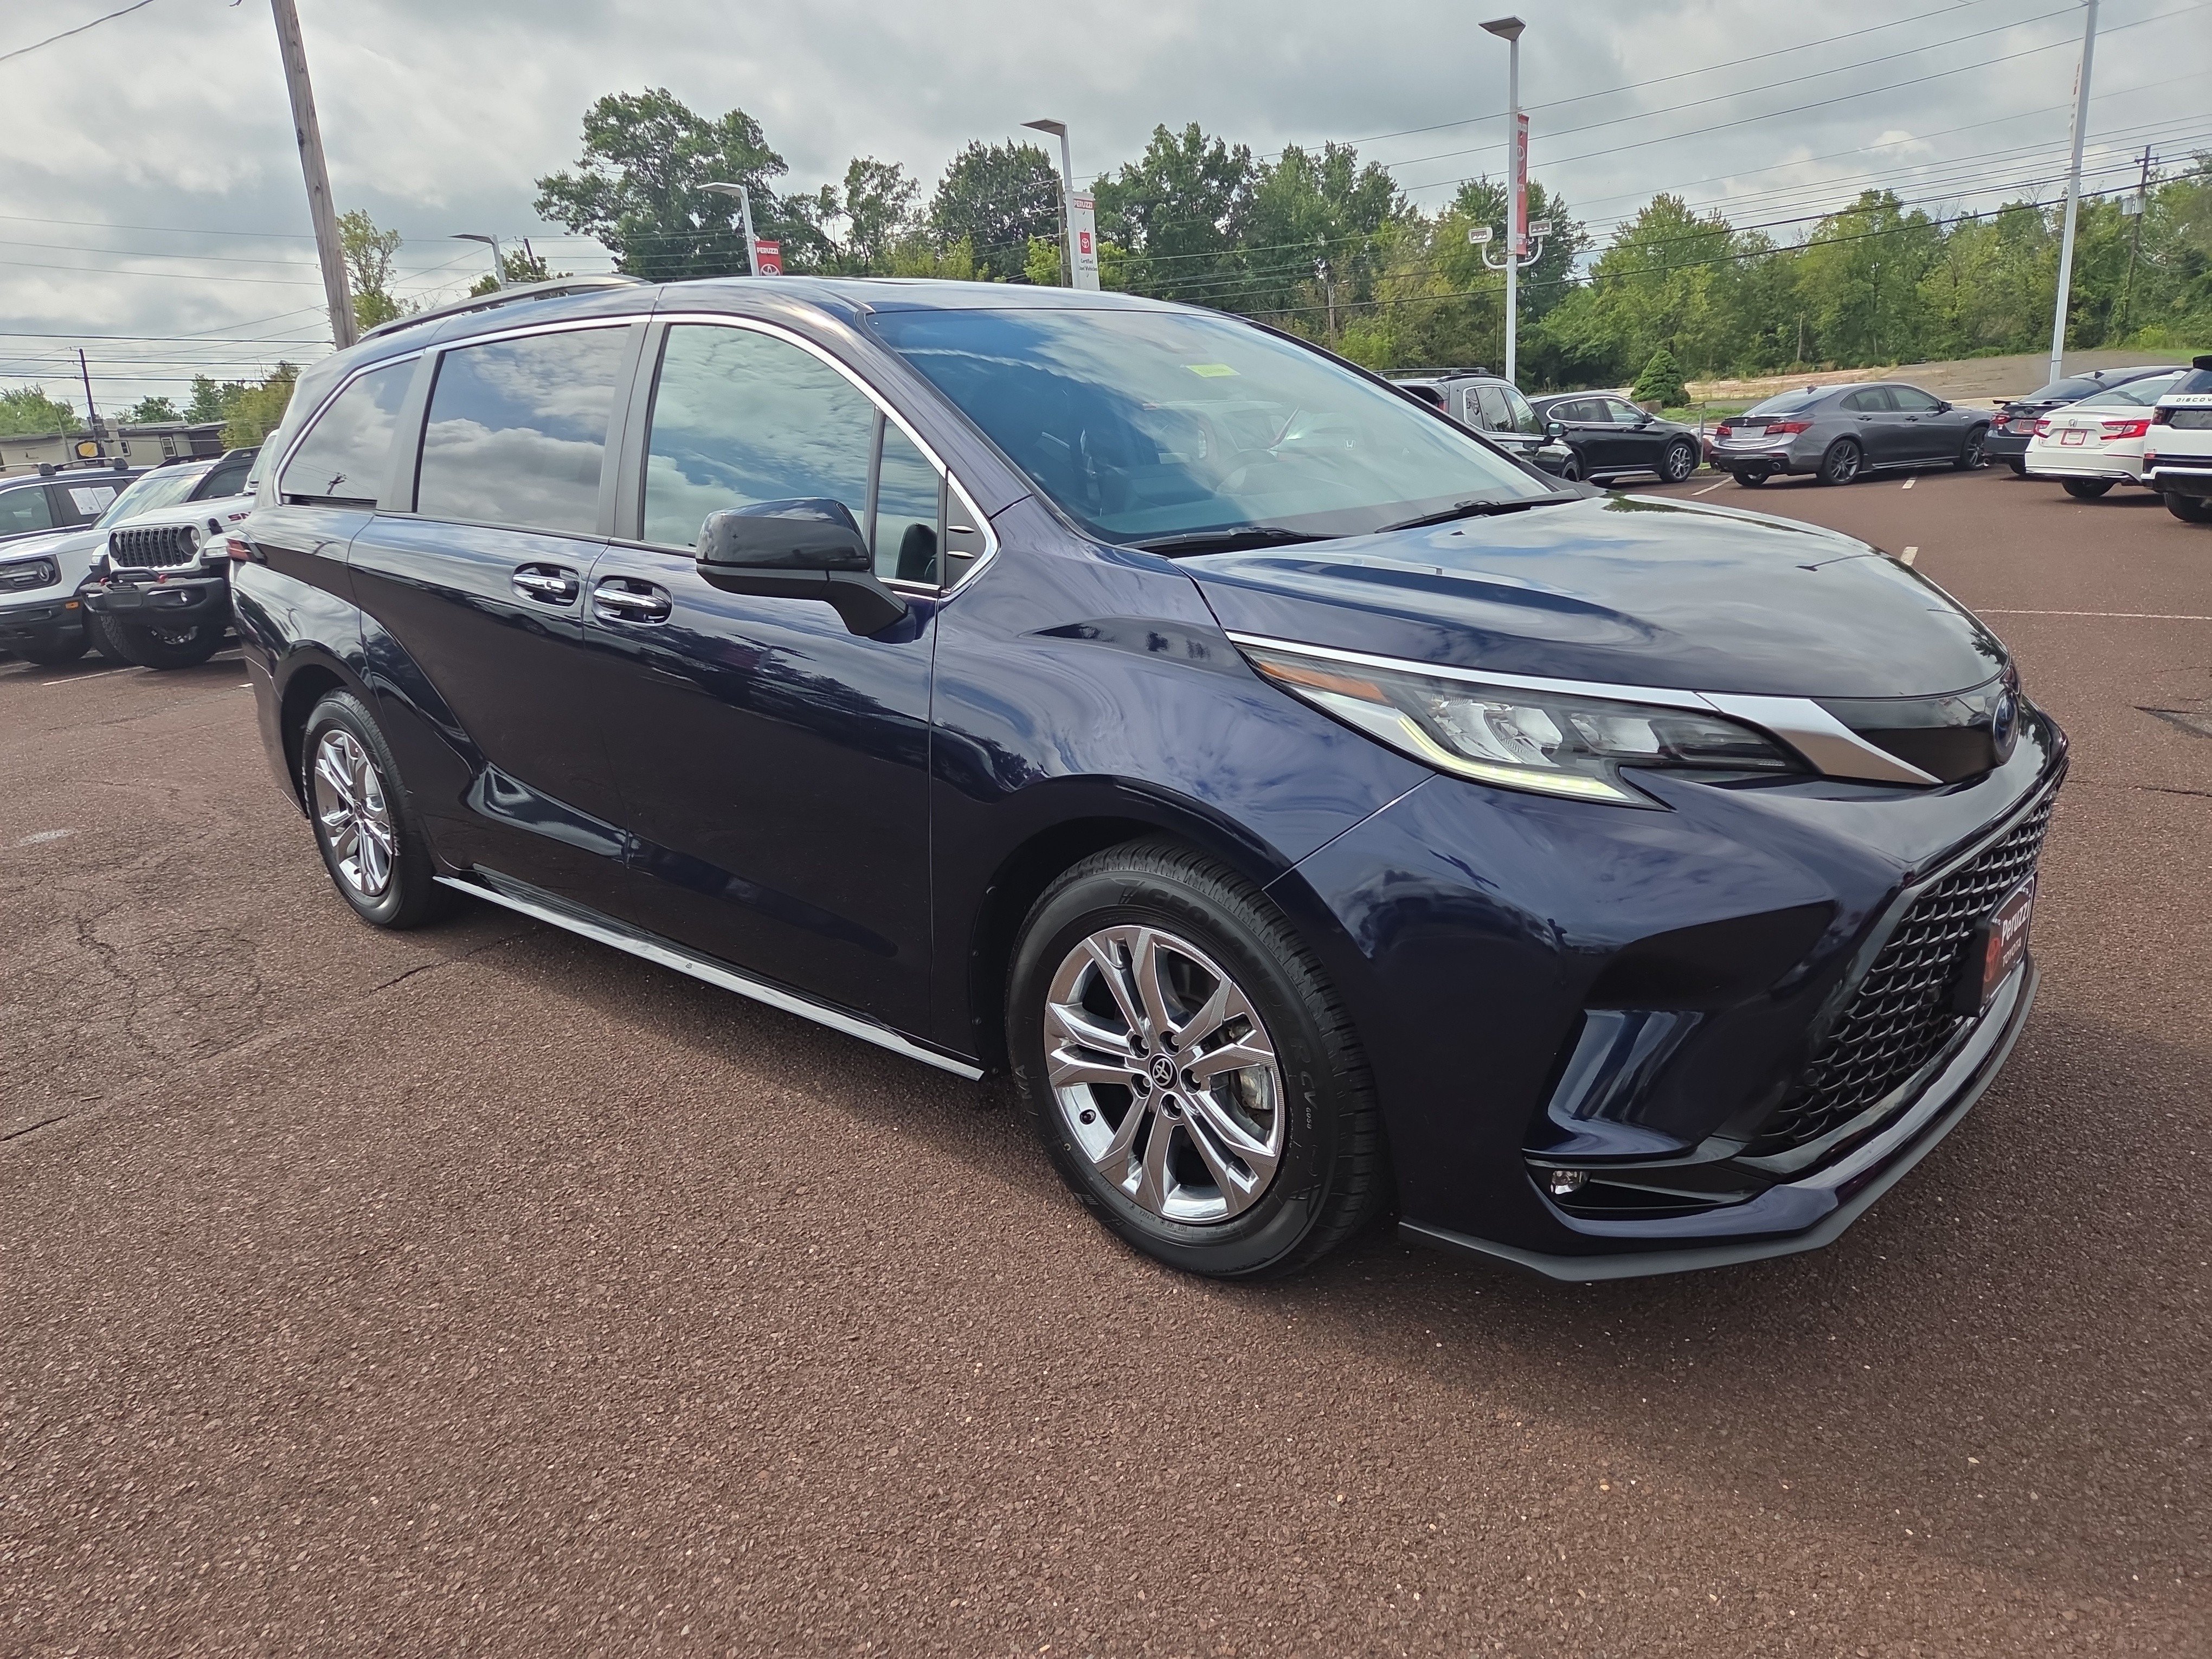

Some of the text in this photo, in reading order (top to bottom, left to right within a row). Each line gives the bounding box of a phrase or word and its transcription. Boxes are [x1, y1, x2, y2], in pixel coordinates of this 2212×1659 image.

[757, 247, 779, 255] PERUZZI
[2001, 893, 2031, 948] Peruzzi
[2003, 936, 2021, 968] TOYOTA
